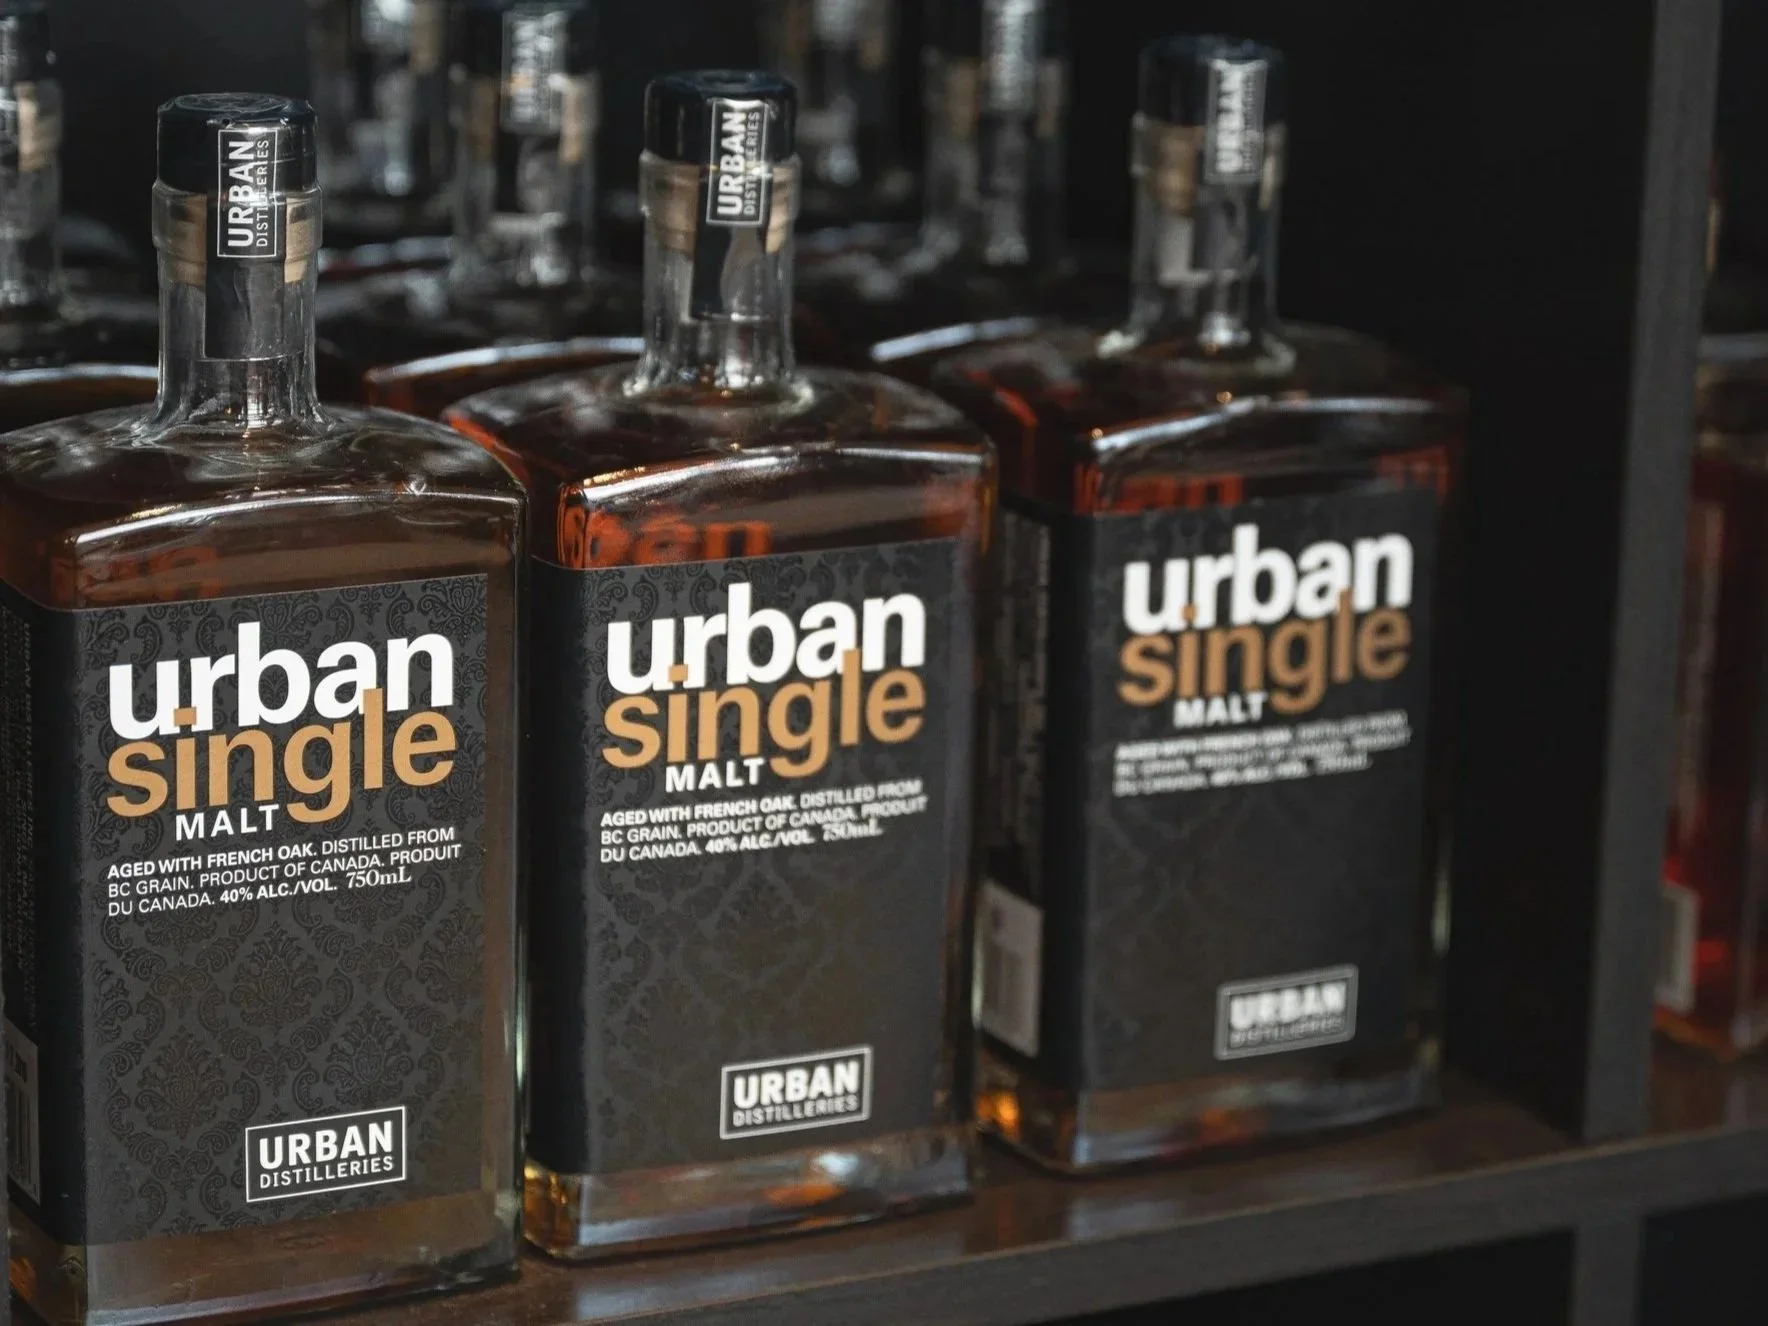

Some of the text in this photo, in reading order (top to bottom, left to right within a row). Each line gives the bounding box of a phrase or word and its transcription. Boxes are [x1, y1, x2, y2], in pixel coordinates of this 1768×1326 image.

[717, 111, 746, 215] URBAN
[227, 141, 255, 247] URBAN
[256, 139, 269, 247] DISTILLERIES
[1123, 523, 1414, 635] urban
[606, 582, 926, 695] urban
[1117, 586, 1412, 714] single
[109, 621, 454, 740] urban
[602, 648, 926, 777] single
[1173, 691, 1268, 728] MALT
[107, 688, 456, 823] single
[665, 757, 766, 793] MALT
[175, 804, 279, 841] MALT
[600, 810, 647, 827] AGED
[649, 805, 692, 824] WITH
[694, 799, 757, 819] FRENCH
[800, 786, 875, 809] DISTILLED
[601, 830, 623, 845] BC
[627, 825, 682, 843] GRAIN.
[687, 816, 763, 838] PRODUCT
[765, 813, 787, 830] OF
[107, 827, 455, 879] AGED WITH FRENCH OAK. DISTILLED FROM
[108, 844, 462, 898] BC GRAIN. PRODUCT OF CANADA. PRODUIT
[600, 848, 625, 863] DU
[629, 841, 702, 861] CANADA.
[108, 866, 412, 916] DU CANADA. 40% ALC./VOL. 750mL
[733, 1059, 860, 1109] URBAN
[732, 1093, 859, 1127] DISTILLERIES
[259, 1121, 392, 1170] URBAN
[259, 1155, 394, 1189] DISTILLERIES
